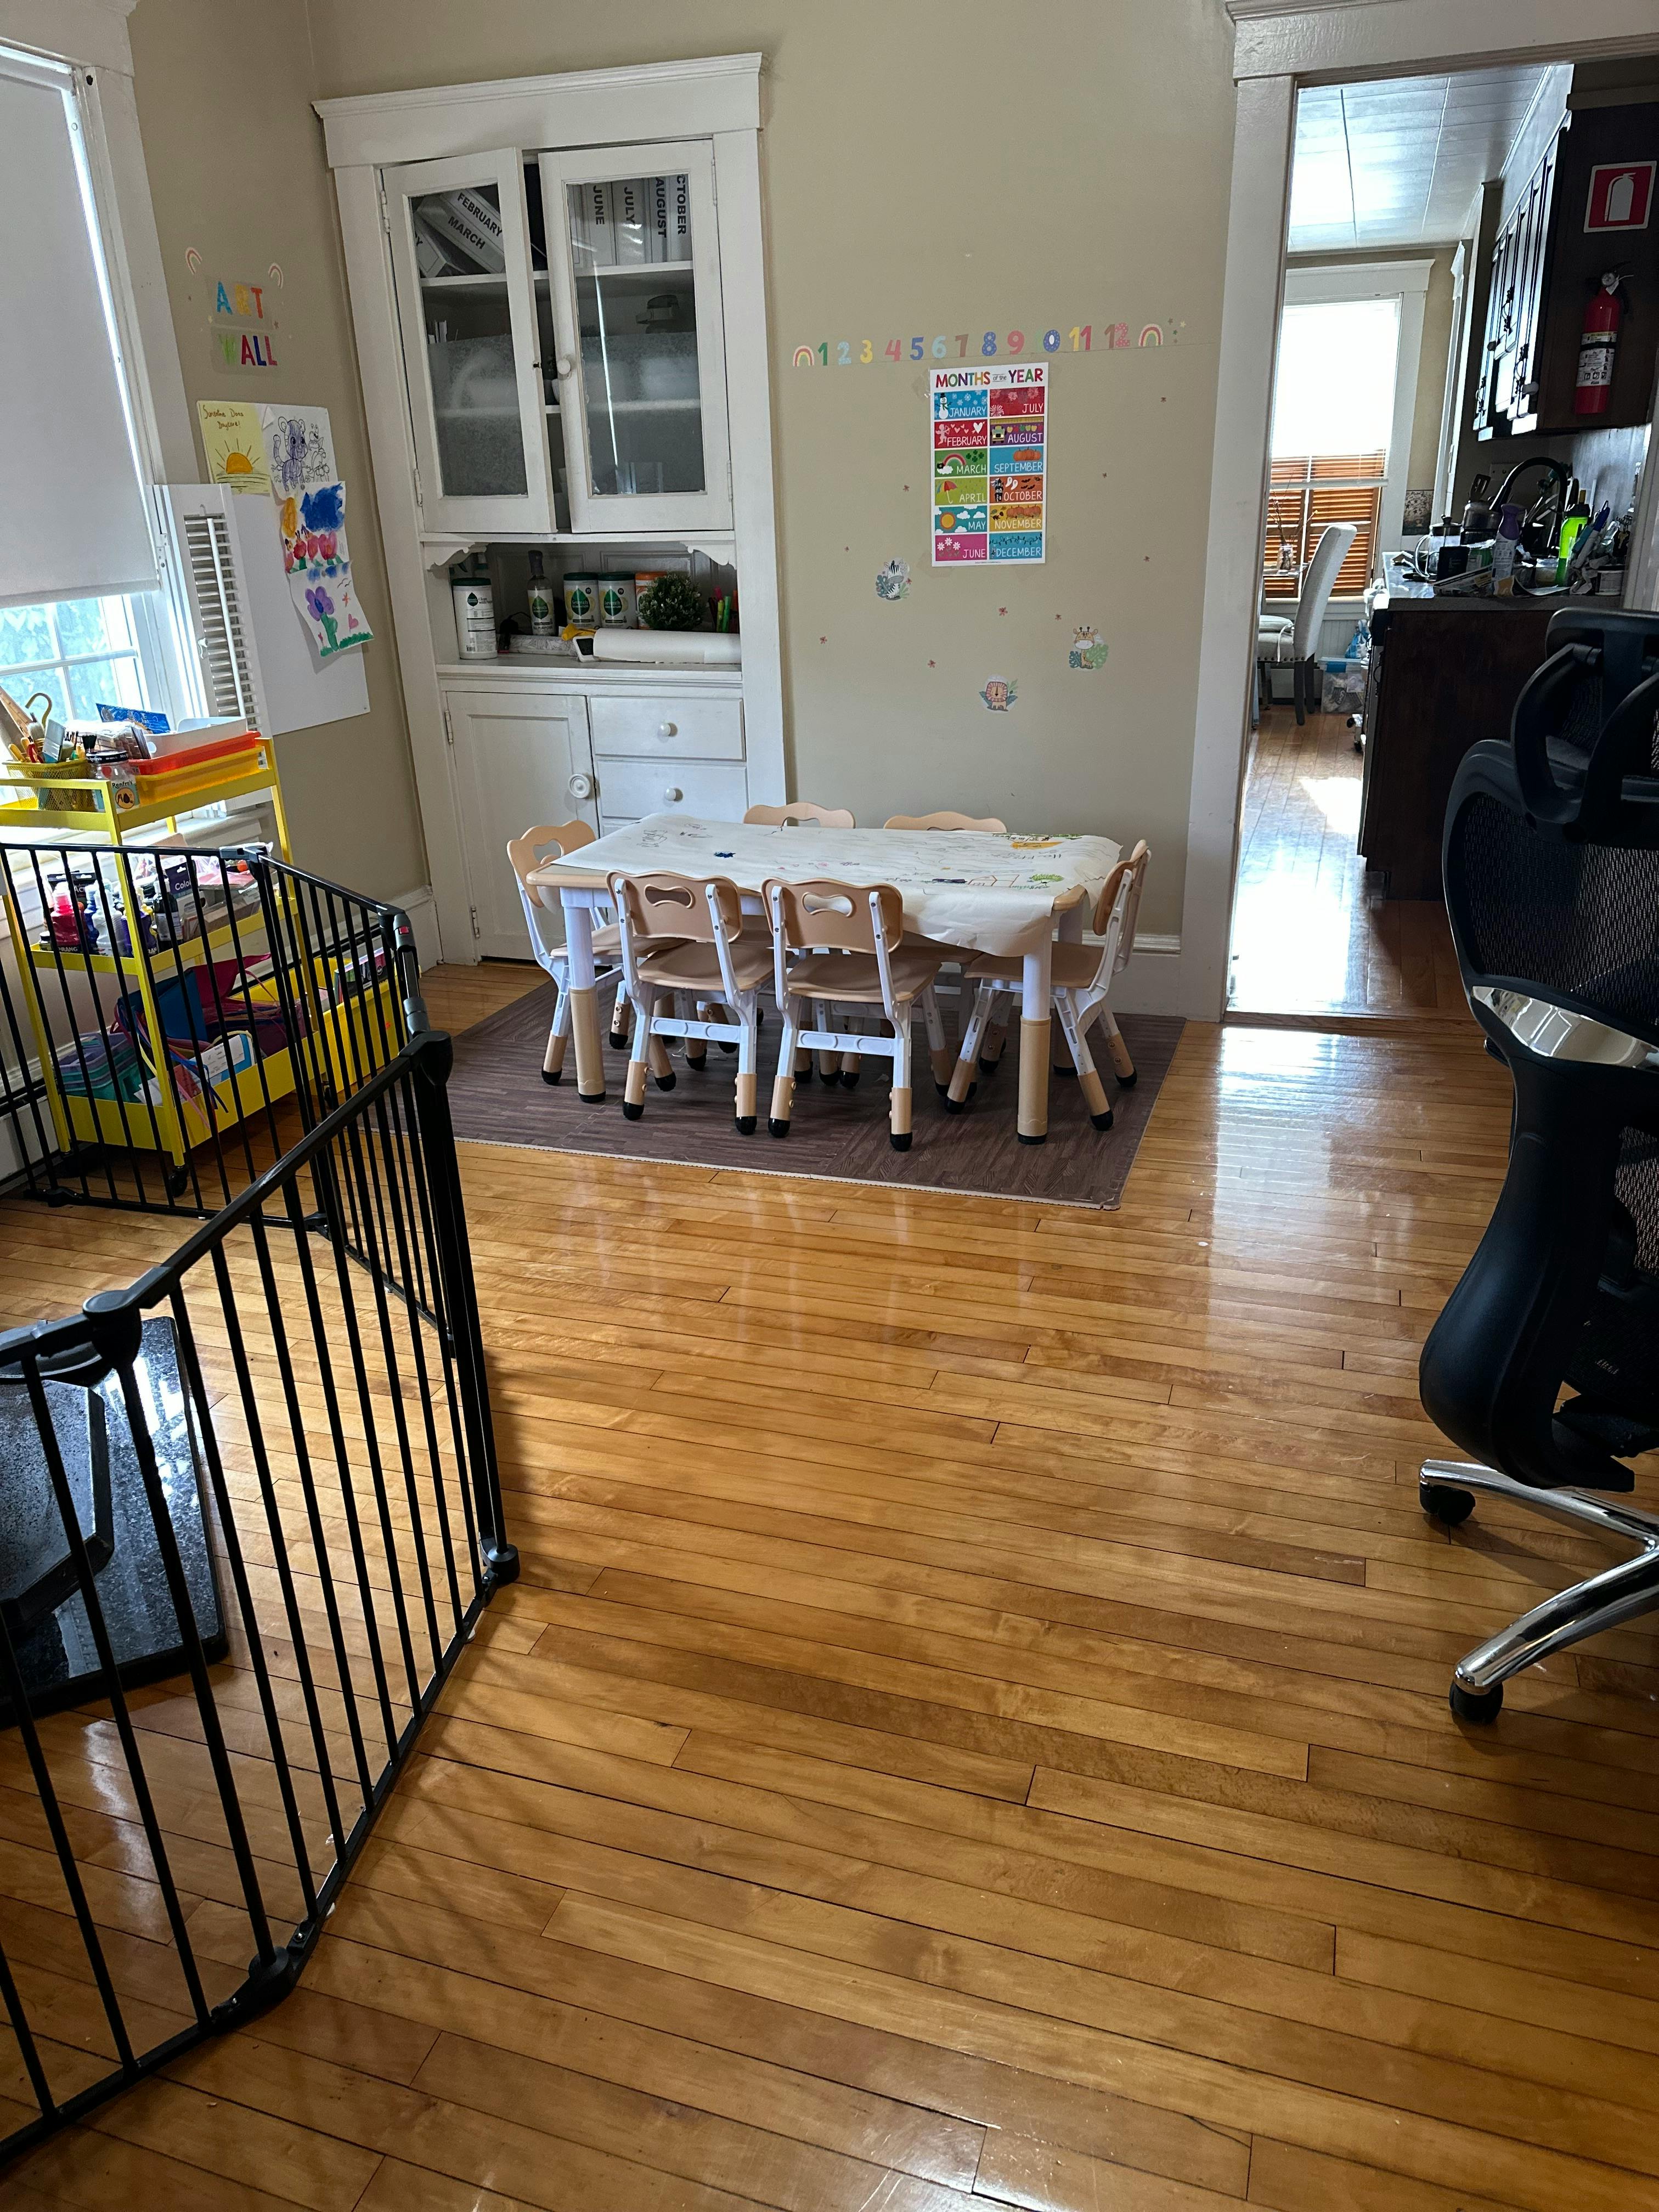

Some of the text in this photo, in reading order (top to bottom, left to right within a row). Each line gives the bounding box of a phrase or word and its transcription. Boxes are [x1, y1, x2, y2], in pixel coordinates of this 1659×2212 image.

[594, 185, 605, 224] JUNE
[624, 187, 635, 225] JULY
[656, 177, 667, 238] AUGUST
[676, 174, 686, 234] CTOBER
[458, 193, 503, 236] FEBRUARY
[448, 216, 486, 249] MARCH
[217, 280, 263, 319] ART
[218, 334, 278, 366] WALL
[817, 342, 828, 366] 1
[837, 341, 851, 365] 2
[860, 339, 873, 363] 3
[884, 339, 901, 362] 4
[910, 337, 924, 360] 5
[932, 335, 947, 358] 6
[955, 334, 969, 357] 7
[981, 331, 997, 356] 8
[1007, 330, 1024, 355] 9
[1069, 325, 1092, 351] 11
[1104, 322, 1130, 349] 12
[935, 371, 991, 388] MONTHS
[1008, 368, 1043, 383] YEAR
[949, 406, 987, 417] JANUARY
[1022, 403, 1044, 413] JULY
[947, 435, 987, 447] FEBRUARY
[1008, 432, 1043, 443] AUGUST
[956, 464, 986, 475] MARCH
[994, 461, 1043, 473] SEPTEMBER
[959, 493, 986, 503] APRIL
[1003, 490, 1042, 501] OCTOBER
[968, 521, 986, 531] MAY
[995, 518, 1042, 529] NOVEMBER
[962, 549, 986, 558] JUNE
[996, 547, 1041, 557] DECEMBER
